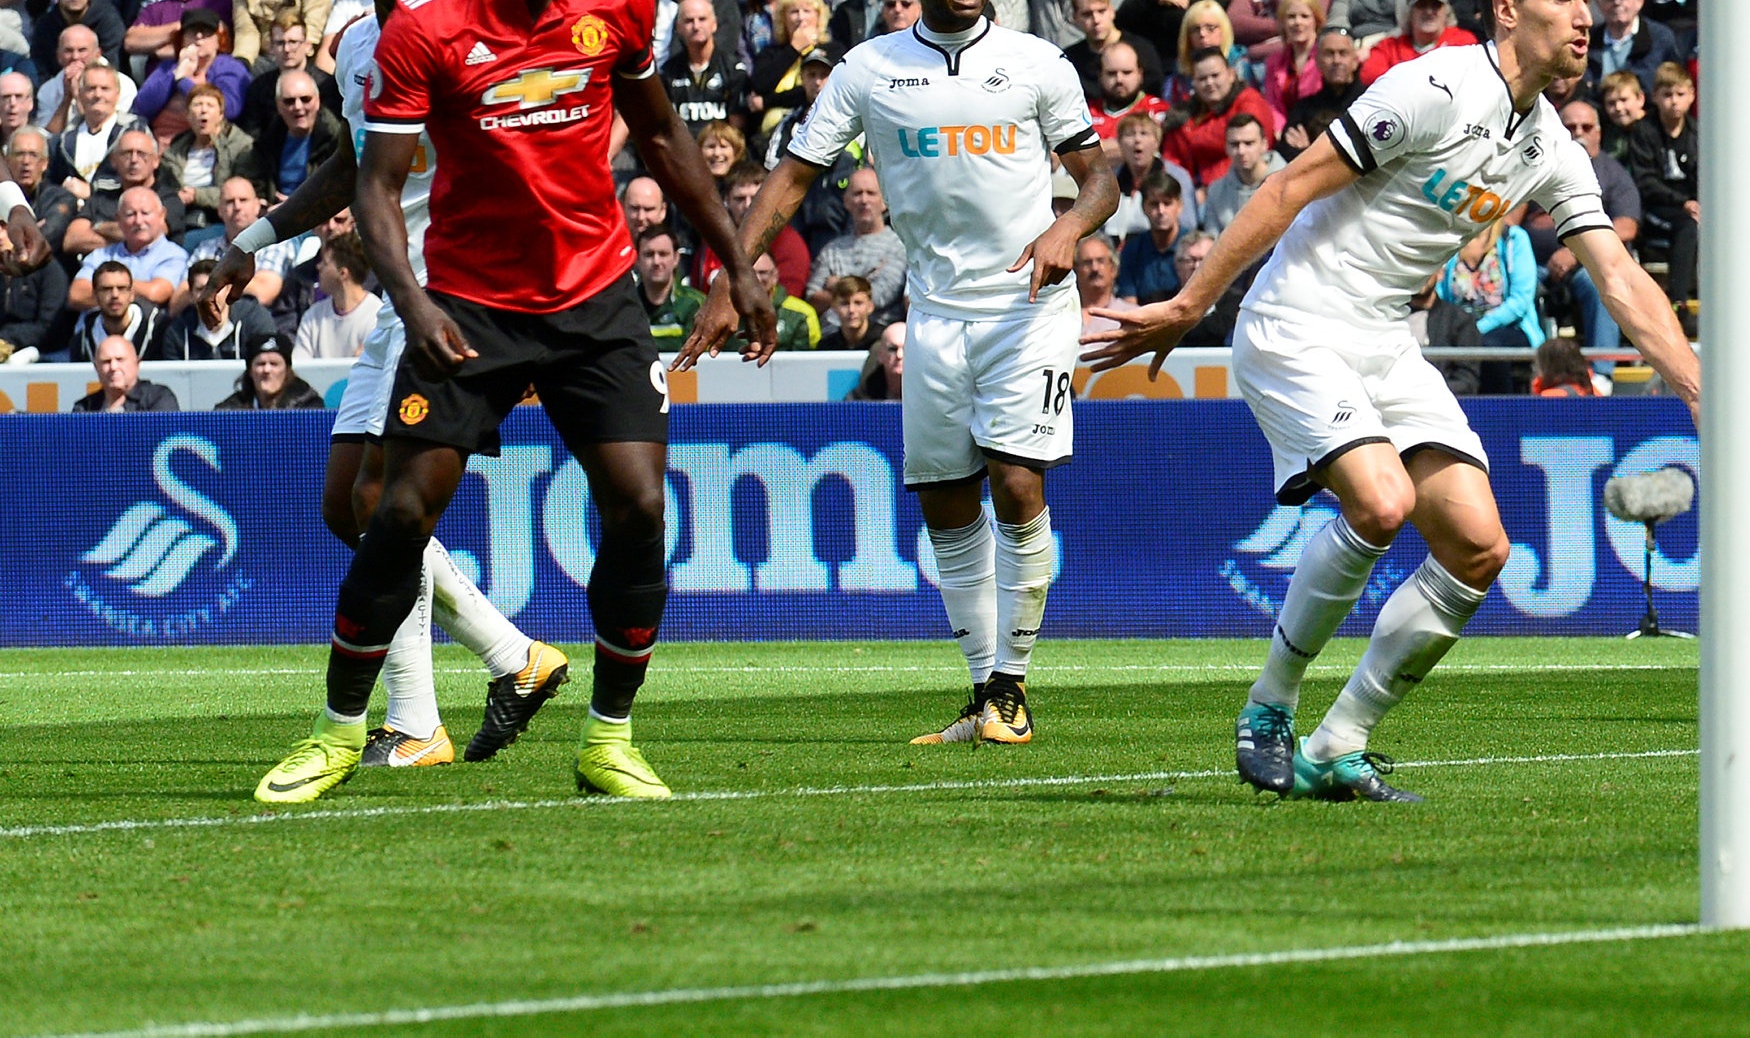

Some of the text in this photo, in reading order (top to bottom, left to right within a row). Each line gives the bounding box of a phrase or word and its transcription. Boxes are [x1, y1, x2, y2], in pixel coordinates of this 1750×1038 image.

[480, 104, 591, 131] CHEVROLET
[672, 102, 727, 121] ETOU
[897, 125, 1018, 159] LETOU
[1042, 368, 1070, 417] 18
